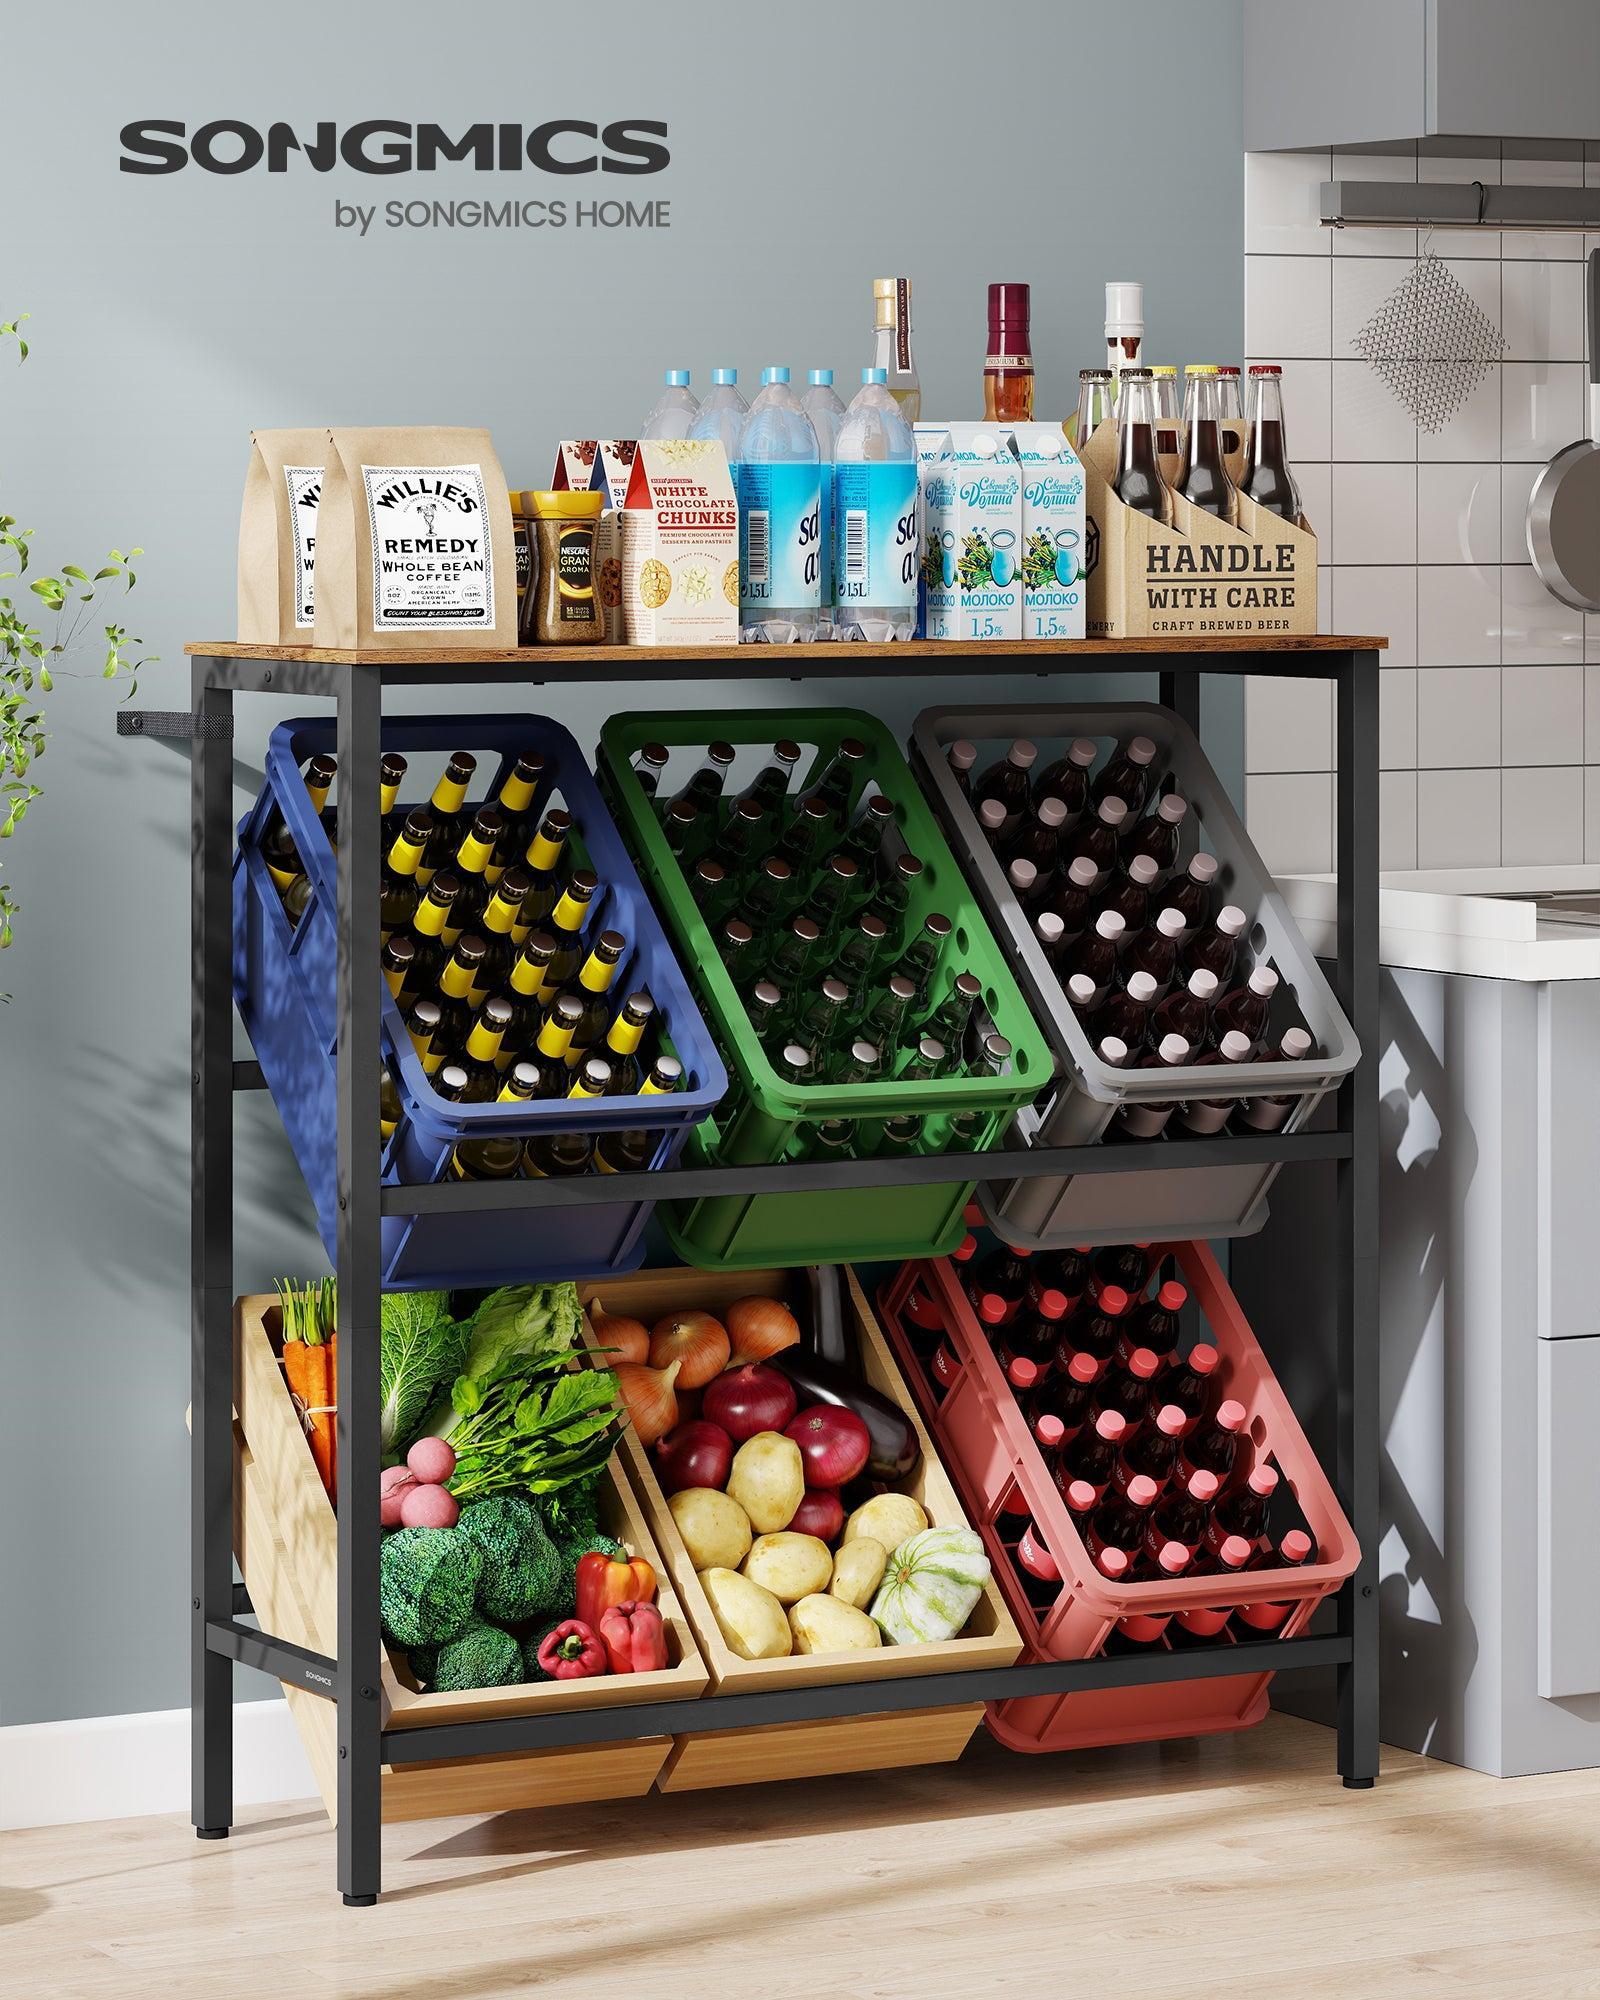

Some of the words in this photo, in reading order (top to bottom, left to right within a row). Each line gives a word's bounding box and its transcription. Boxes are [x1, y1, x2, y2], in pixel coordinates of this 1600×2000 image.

[376, 478, 478, 513] WILLIE'S
[653, 486, 708, 496] WHITE
[960, 482, 1013, 509] Долина
[1024, 482, 1077, 509] Долина
[656, 499, 735, 508] CHOCOLATE
[657, 511, 736, 524] CHUNKS
[385, 538, 479, 553] REMEDY
[560, 545, 590, 556] NESCAFÉ
[382, 560, 435, 572] WHOLE
[441, 559, 484, 572] BEAN
[560, 556, 590, 566] GRAN
[1146, 544, 1295, 573] HANDLE
[406, 573, 461, 581] COFFEE
[927, 592, 955, 607] МОЛОКО
[961, 592, 1015, 607] МОЛОКО
[1025, 592, 1079, 606] МОЛОКО
[1147, 588, 1217, 609] WITH
[1226, 587, 1295, 608] CARE
[1152, 621, 1195, 631] CRAFT
[1199, 620, 1252, 630] BREWED
[1257, 620, 1290, 630] BEER
